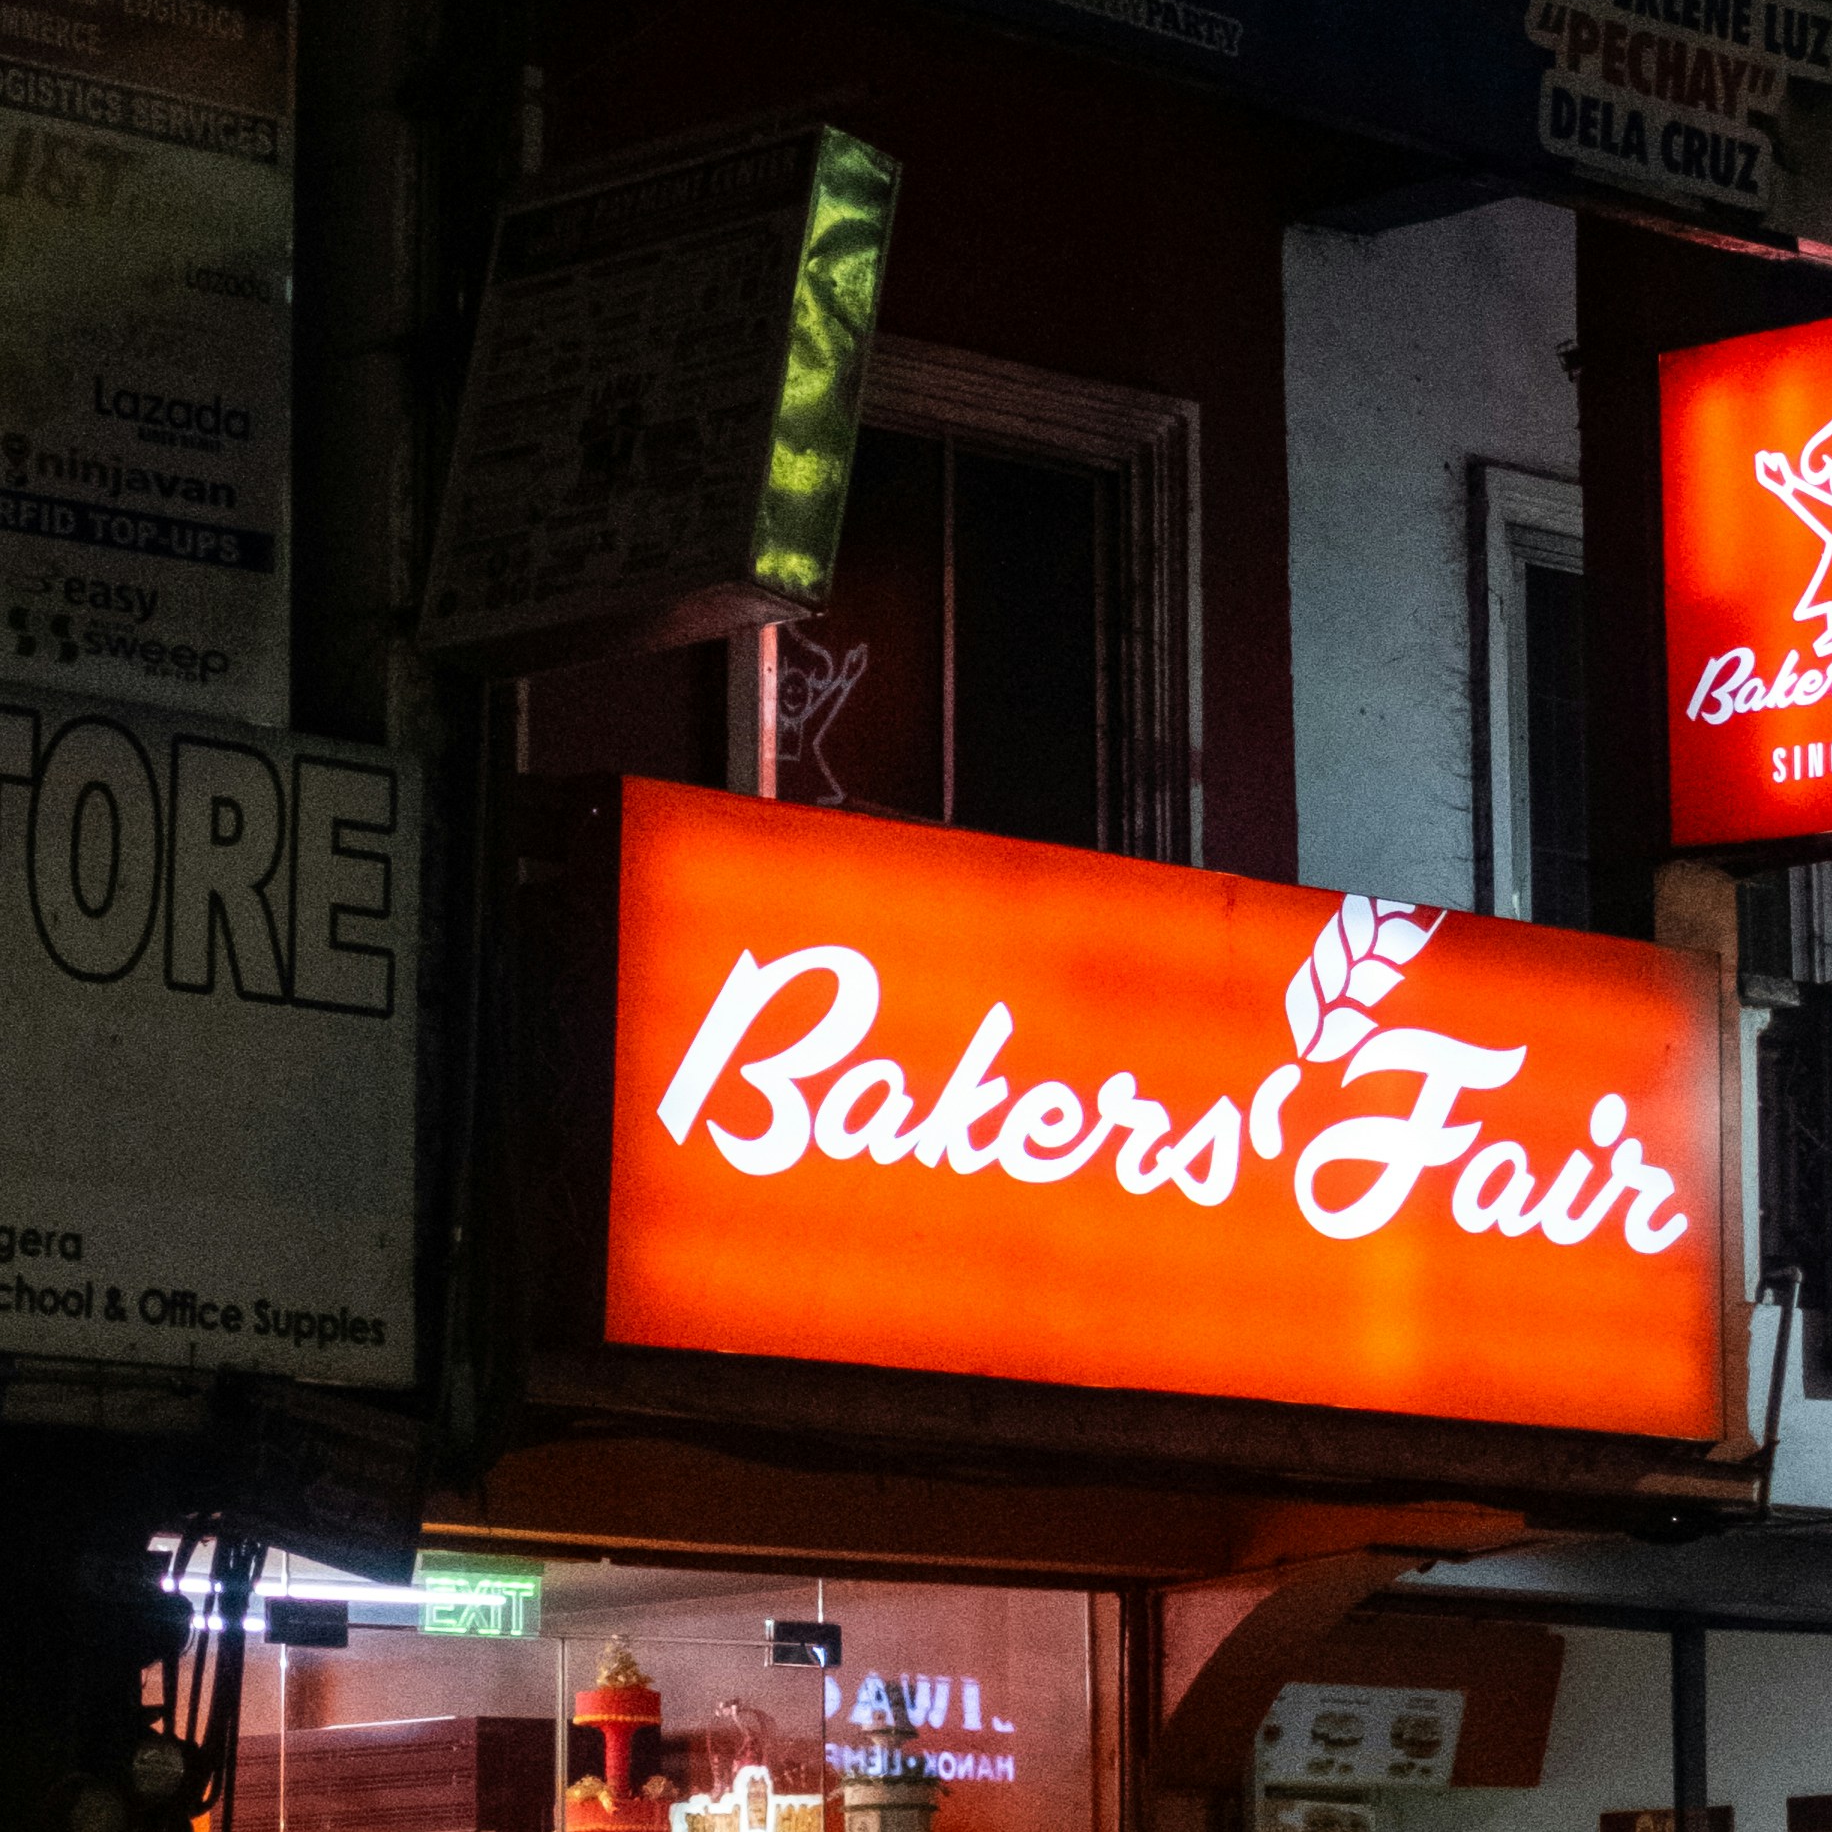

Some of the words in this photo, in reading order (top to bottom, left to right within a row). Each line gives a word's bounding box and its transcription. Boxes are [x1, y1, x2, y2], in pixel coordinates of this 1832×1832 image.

[0, 66, 122, 125] GISTICS
[131, 94, 277, 158] SERVICES
[1550, 88, 1650, 167] DELA
[1660, 121, 1761, 193] CRUZ
[96, 380, 251, 443] Lazada
[0, 497, 76, 536] RFID
[90, 512, 241, 565] TOP-UPS
[64, 576, 158, 625] easy
[84, 631, 229, 683] sweep
[1293, 1026, 1689, 1256] Fair
[105, 1286, 127, 1323] &
[138, 1288, 243, 1334] Office
[423, 1577, 536, 1637] EXIT
